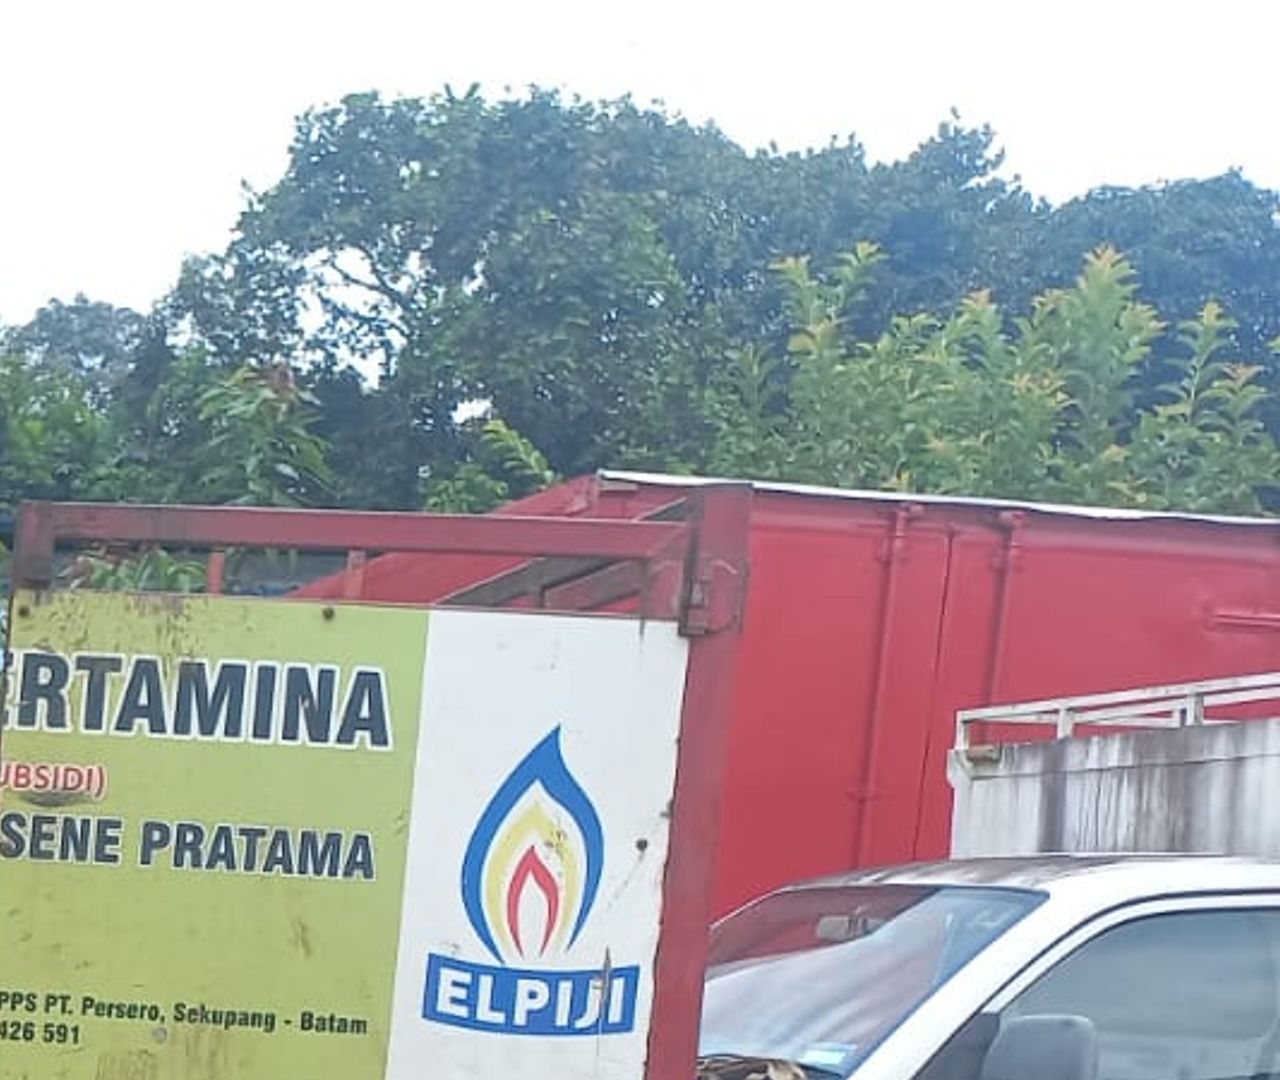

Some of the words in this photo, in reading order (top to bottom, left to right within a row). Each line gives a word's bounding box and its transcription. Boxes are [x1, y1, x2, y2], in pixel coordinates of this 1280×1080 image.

[140, 821, 376, 880] PRATAMA
[44, 995, 74, 1016] PT.
[81, 996, 166, 1024] Persero,
[173, 1003, 276, 1032] Sekupang
[300, 1012, 368, 1036] Batam
[435, 966, 626, 1030] ELPIJI
[42, 1023, 80, 1045] 591
